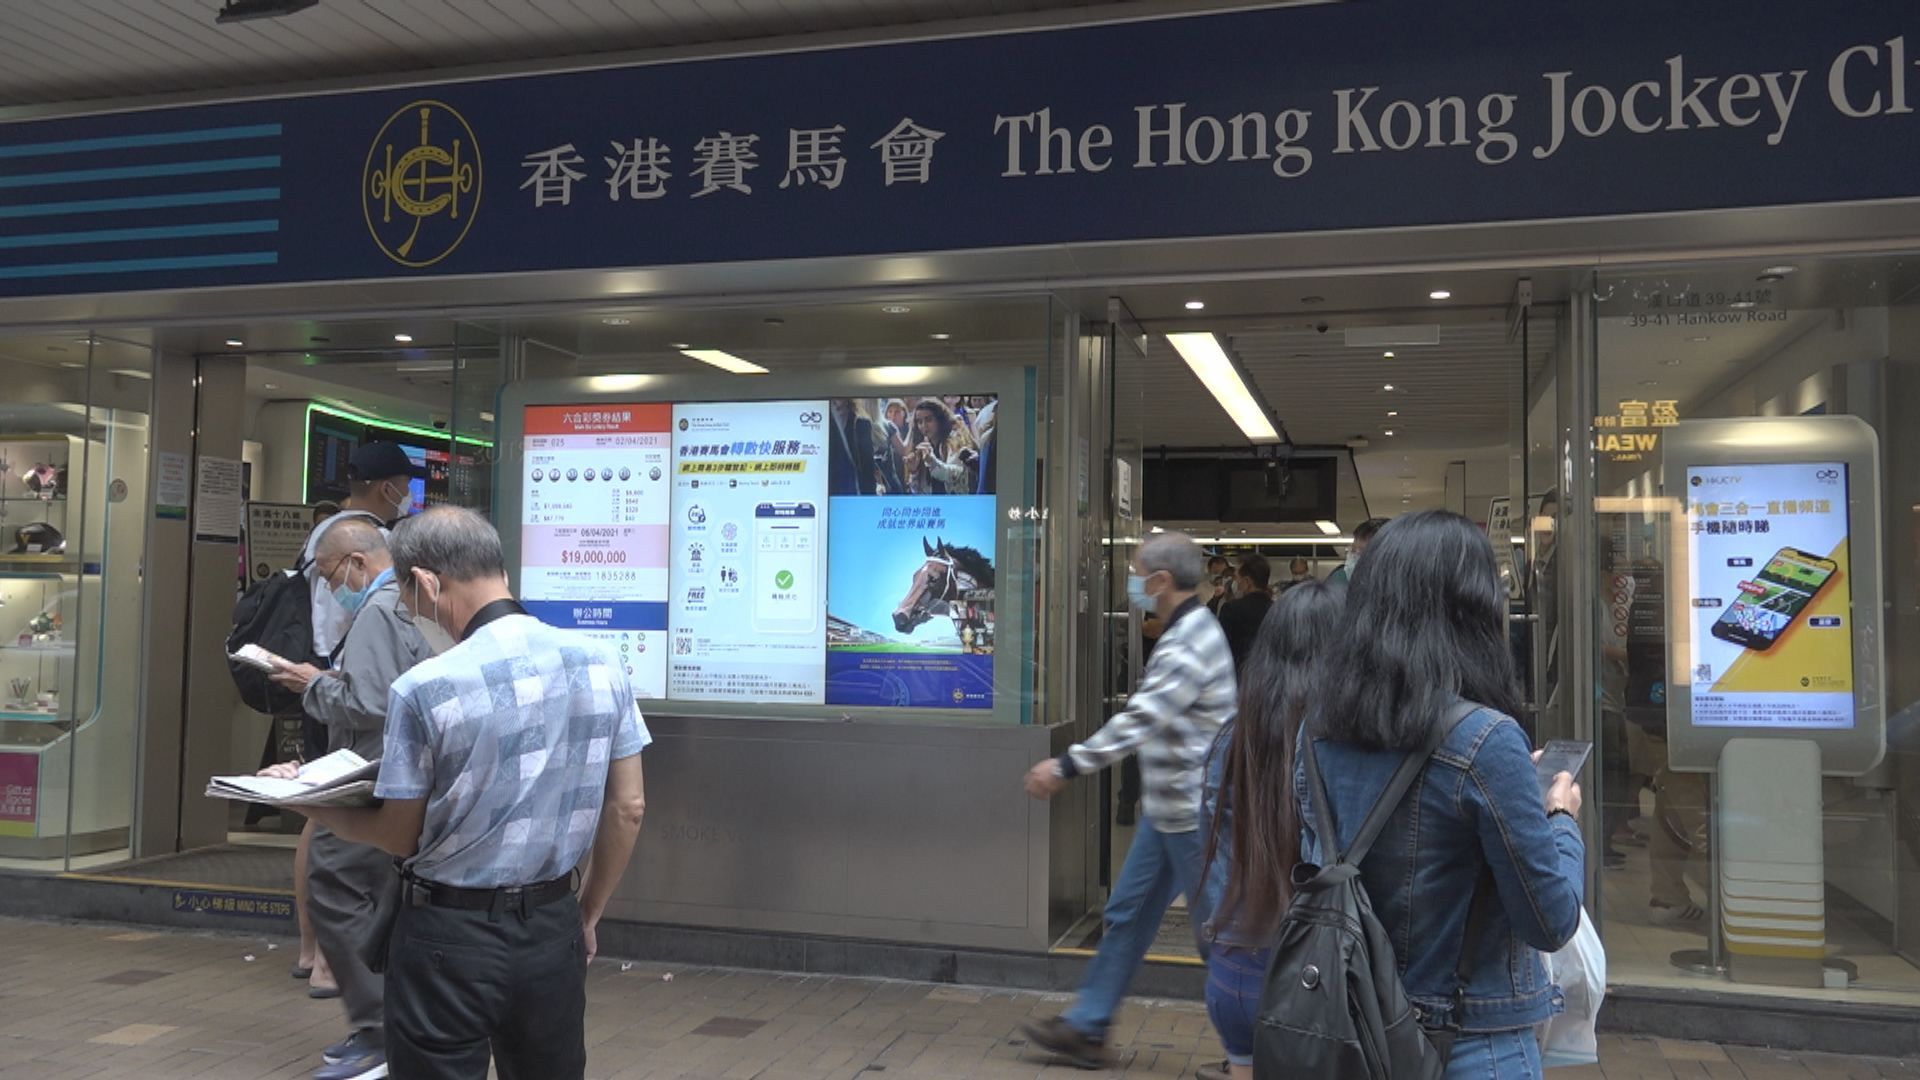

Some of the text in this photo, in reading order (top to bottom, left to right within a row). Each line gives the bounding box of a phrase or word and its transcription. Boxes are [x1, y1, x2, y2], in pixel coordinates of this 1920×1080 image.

[994, 35, 1920, 178] The Hong Kong Jockey Cl
[519, 117, 946, 208] 香港賽馬會
[1630, 308, 1788, 327] 39-41 Hankow Road
[563, 411, 632, 424] 六合彩獎券結果
[551, 438, 565, 447] 025
[615, 436, 658, 446] 02/04/2021
[679, 440, 800, 457] 香港賽馬會轉數快服務
[580, 528, 619, 537] 06/04/2021
[1691, 519, 1770, 535] 手機隨時睇
[561, 550, 627, 564] $19,000,000
[596, 571, 636, 581] 1835288
[573, 608, 613, 619] 辦公時間
[661, 823, 720, 841] SMOKE
[236, 899, 255, 913] MIND
[256, 902, 269, 914] THE
[269, 902, 291, 916] STEPS
